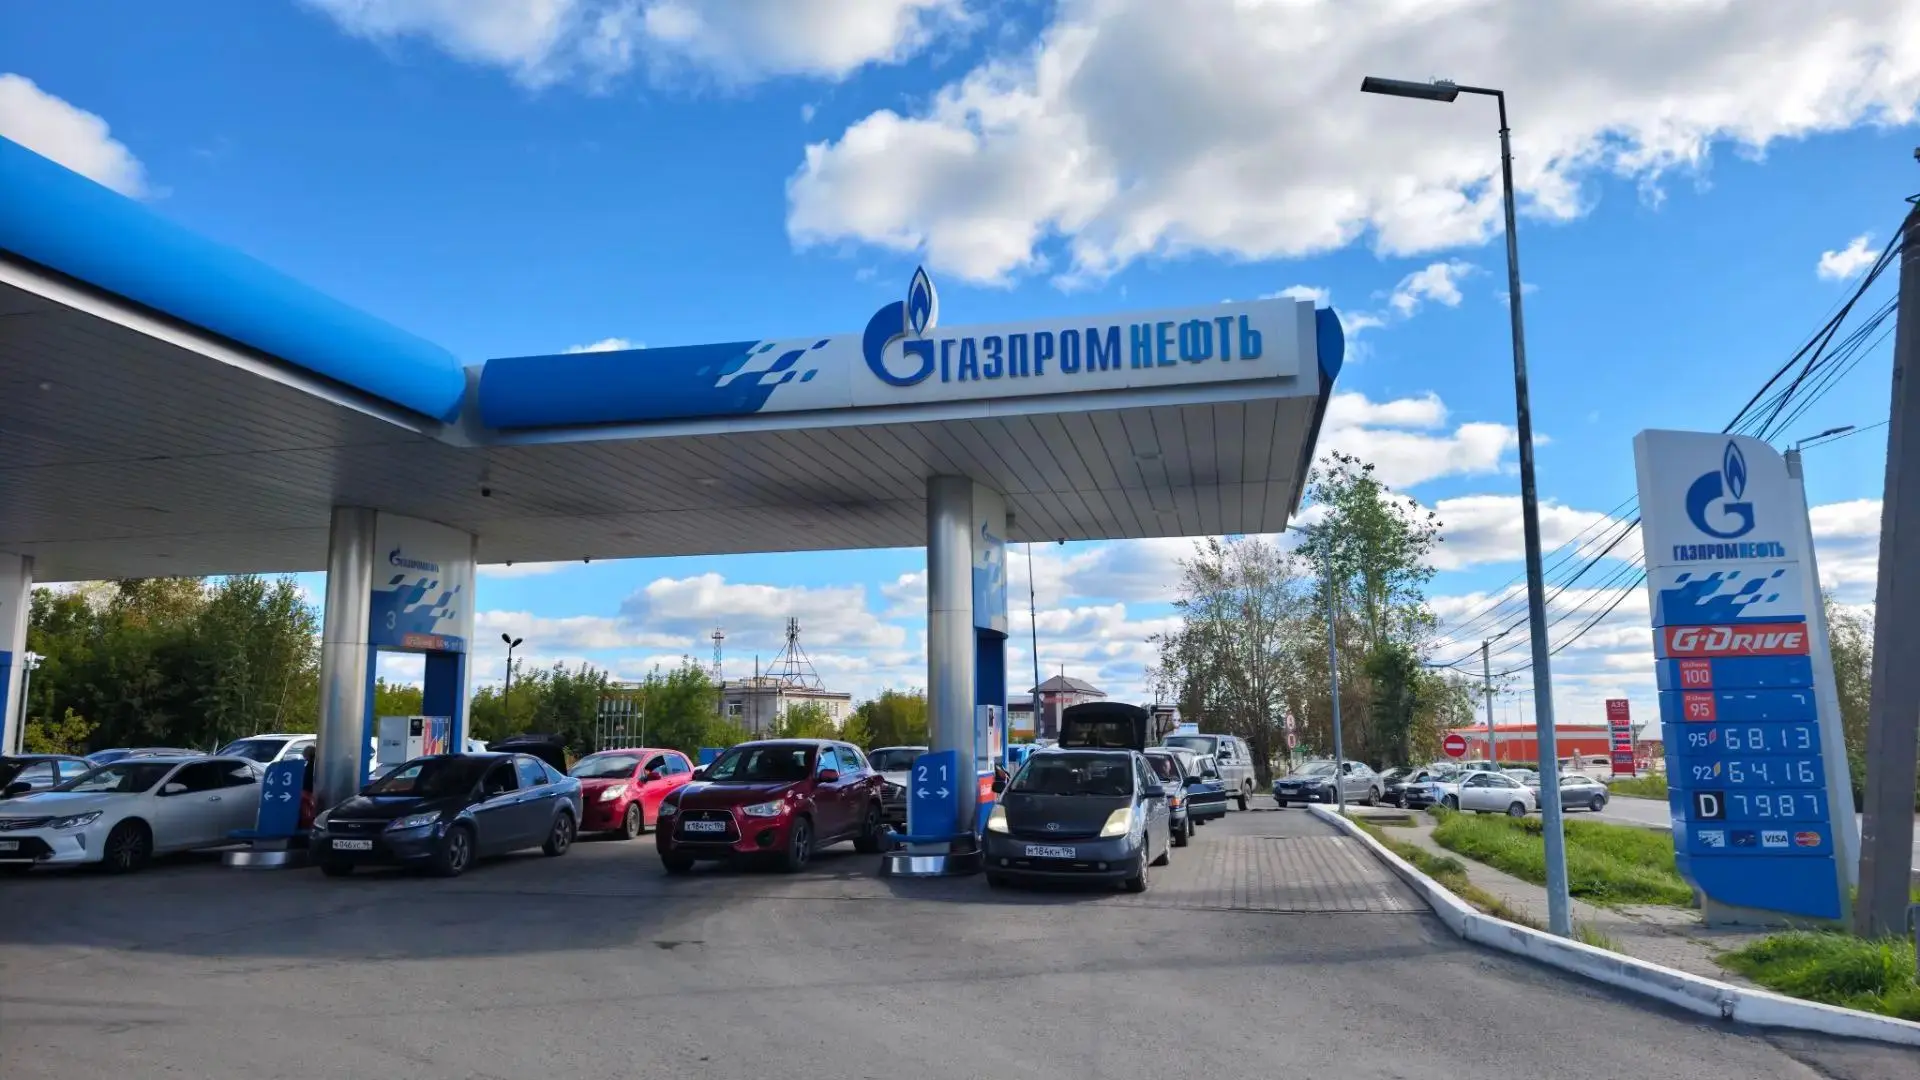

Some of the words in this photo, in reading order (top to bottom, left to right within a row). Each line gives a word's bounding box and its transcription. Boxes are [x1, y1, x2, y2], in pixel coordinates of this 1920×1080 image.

[941, 315, 1262, 382] ГАЗПРОМНЕФТЬ
[1673, 541, 1785, 560] ГАЗПРОМНЕФТЬ
[386, 611, 396, 629] 3
[1684, 669, 1709, 684] 100
[1690, 703, 1710, 717] 95
[1688, 732, 1708, 747] 95
[1724, 728, 1811, 750] 68.13
[266, 772, 274, 785] 4
[282, 772, 292, 786] 3
[918, 766, 929, 781] 2
[939, 765, 947, 781] 1
[1692, 765, 1713, 780] 92
[1728, 761, 1815, 785] 64.16
[1699, 794, 1718, 818] D
[1733, 795, 1819, 818] 79.87
[1765, 835, 1788, 843] VISA
